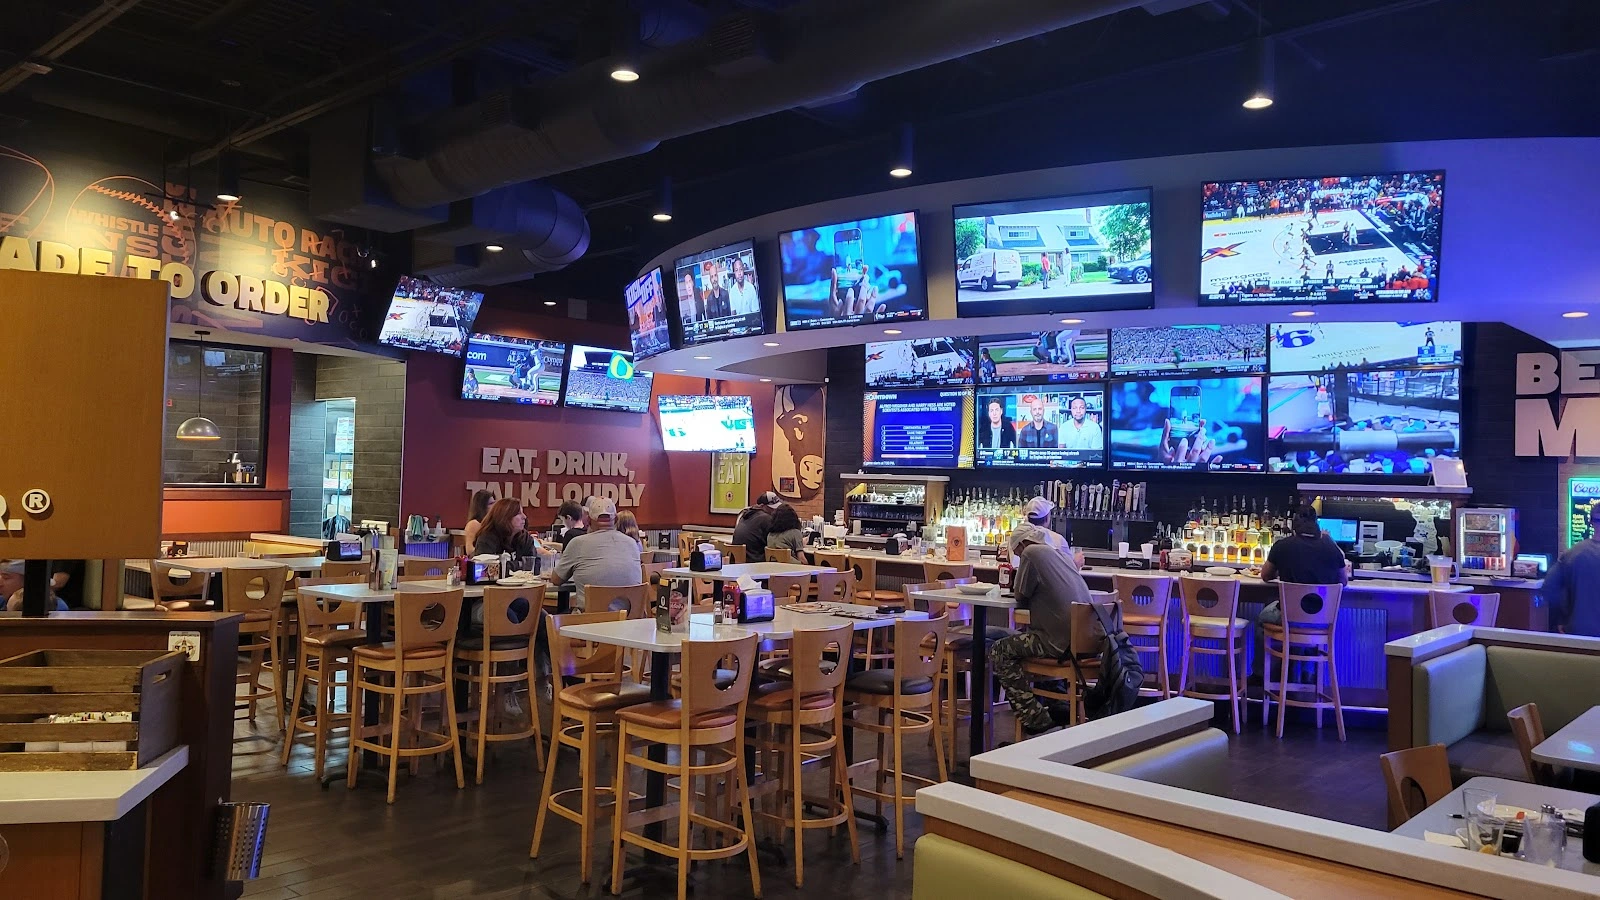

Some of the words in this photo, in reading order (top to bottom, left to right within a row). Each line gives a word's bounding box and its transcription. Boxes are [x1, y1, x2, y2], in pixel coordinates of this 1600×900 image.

[70, 208, 159, 237] WHISTLE
[202, 202, 296, 250] AUTO
[127, 254, 196, 299] TO
[203, 269, 329, 324] ORDER
[466, 350, 486, 361] com
[482, 448, 540, 481] EAT,
[547, 450, 636, 483] DRINK,
[716, 461, 745, 484] EAT
[466, 481, 541, 508] TALK
[547, 482, 646, 508] LOUDLY
